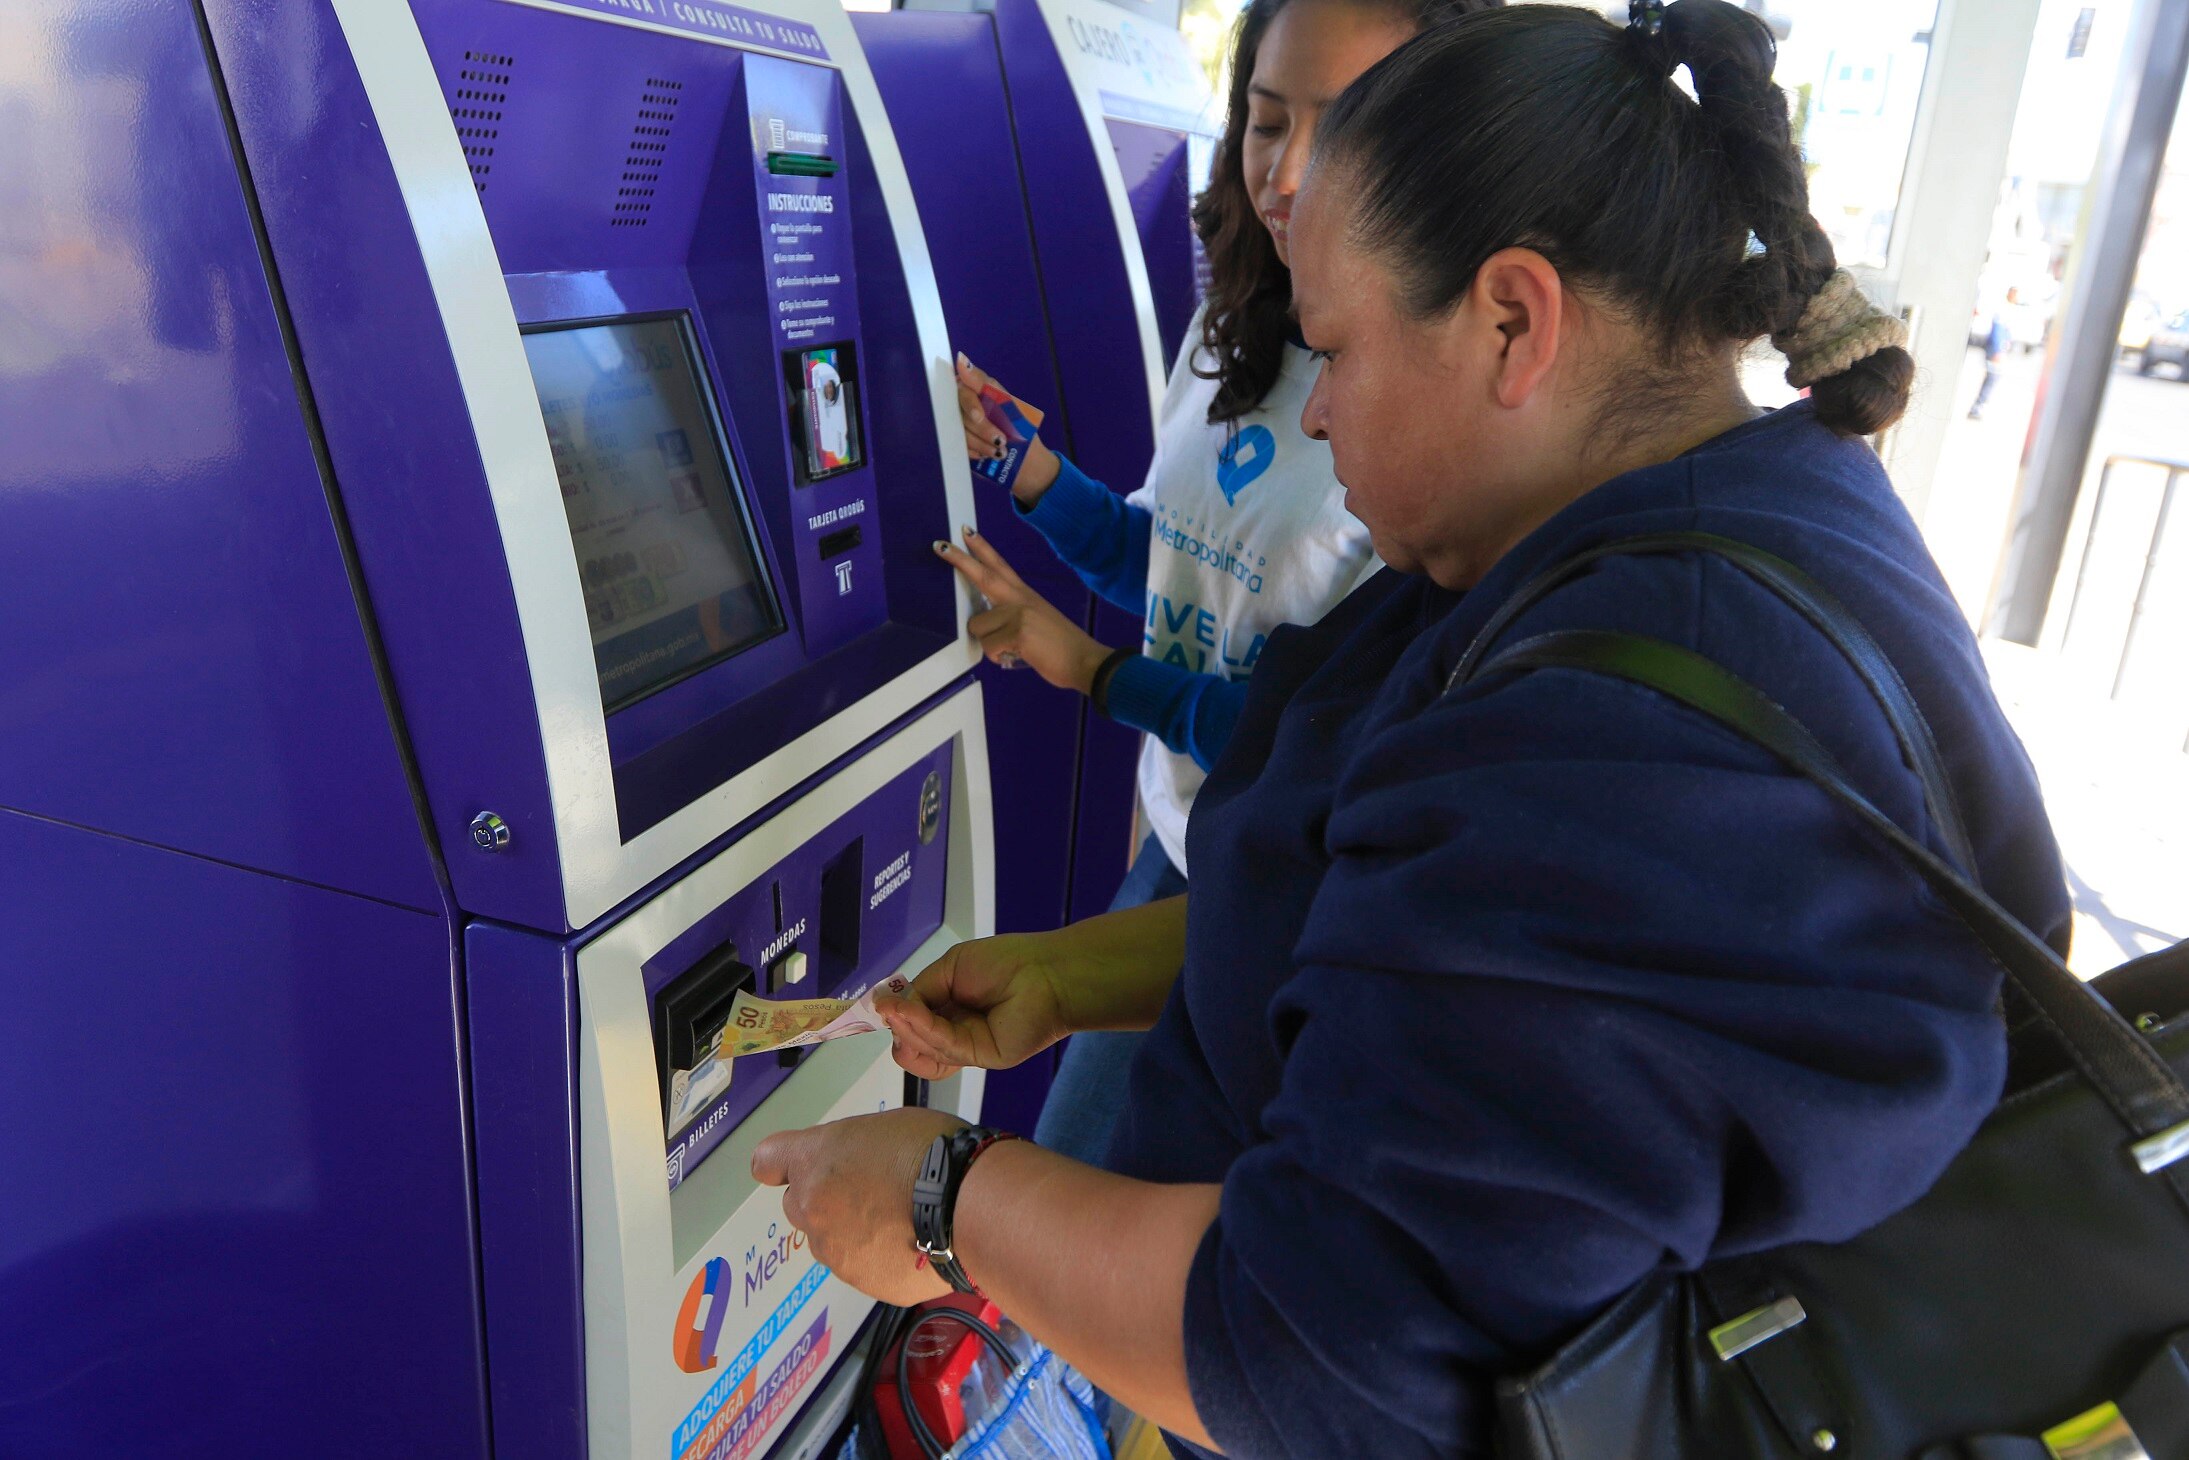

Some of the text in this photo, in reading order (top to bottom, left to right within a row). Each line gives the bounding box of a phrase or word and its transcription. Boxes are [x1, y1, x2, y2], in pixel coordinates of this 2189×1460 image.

[674, 2, 754, 36] CONSULTA
[755, 21, 775, 41] TU
[778, 26, 821, 50] SALDO
[786, 129, 829, 145] COMPROBANTE
[767, 192, 834, 214] INSTRUCCIONES
[998, 447, 1018, 483] CONTACTO
[808, 509, 838, 530] TARJETA
[1154, 516, 1263, 594] Metropolitana
[1147, 589, 1216, 648] IVE
[870, 865, 912, 910] SUGERENCIAS
[874, 849, 910, 890] REPORTES Y
[760, 917, 806, 967] MONEDAS
[803, 1003, 832, 1012] Pesos
[888, 978, 905, 994] 50
[736, 1006, 761, 1030] 50
[759, 1011, 768, 1029] Pesos
[688, 1101, 729, 1149] BILLETES
[679, 1262, 826, 1450] ADQUIERE TU TARJETA
[750, 1386, 768, 1421] TU
[769, 1333, 811, 1397] SALDO
[747, 1410, 769, 1449] UN
[770, 1350, 818, 1420] BOLETO
[684, 1389, 744, 1460] ECARGA
